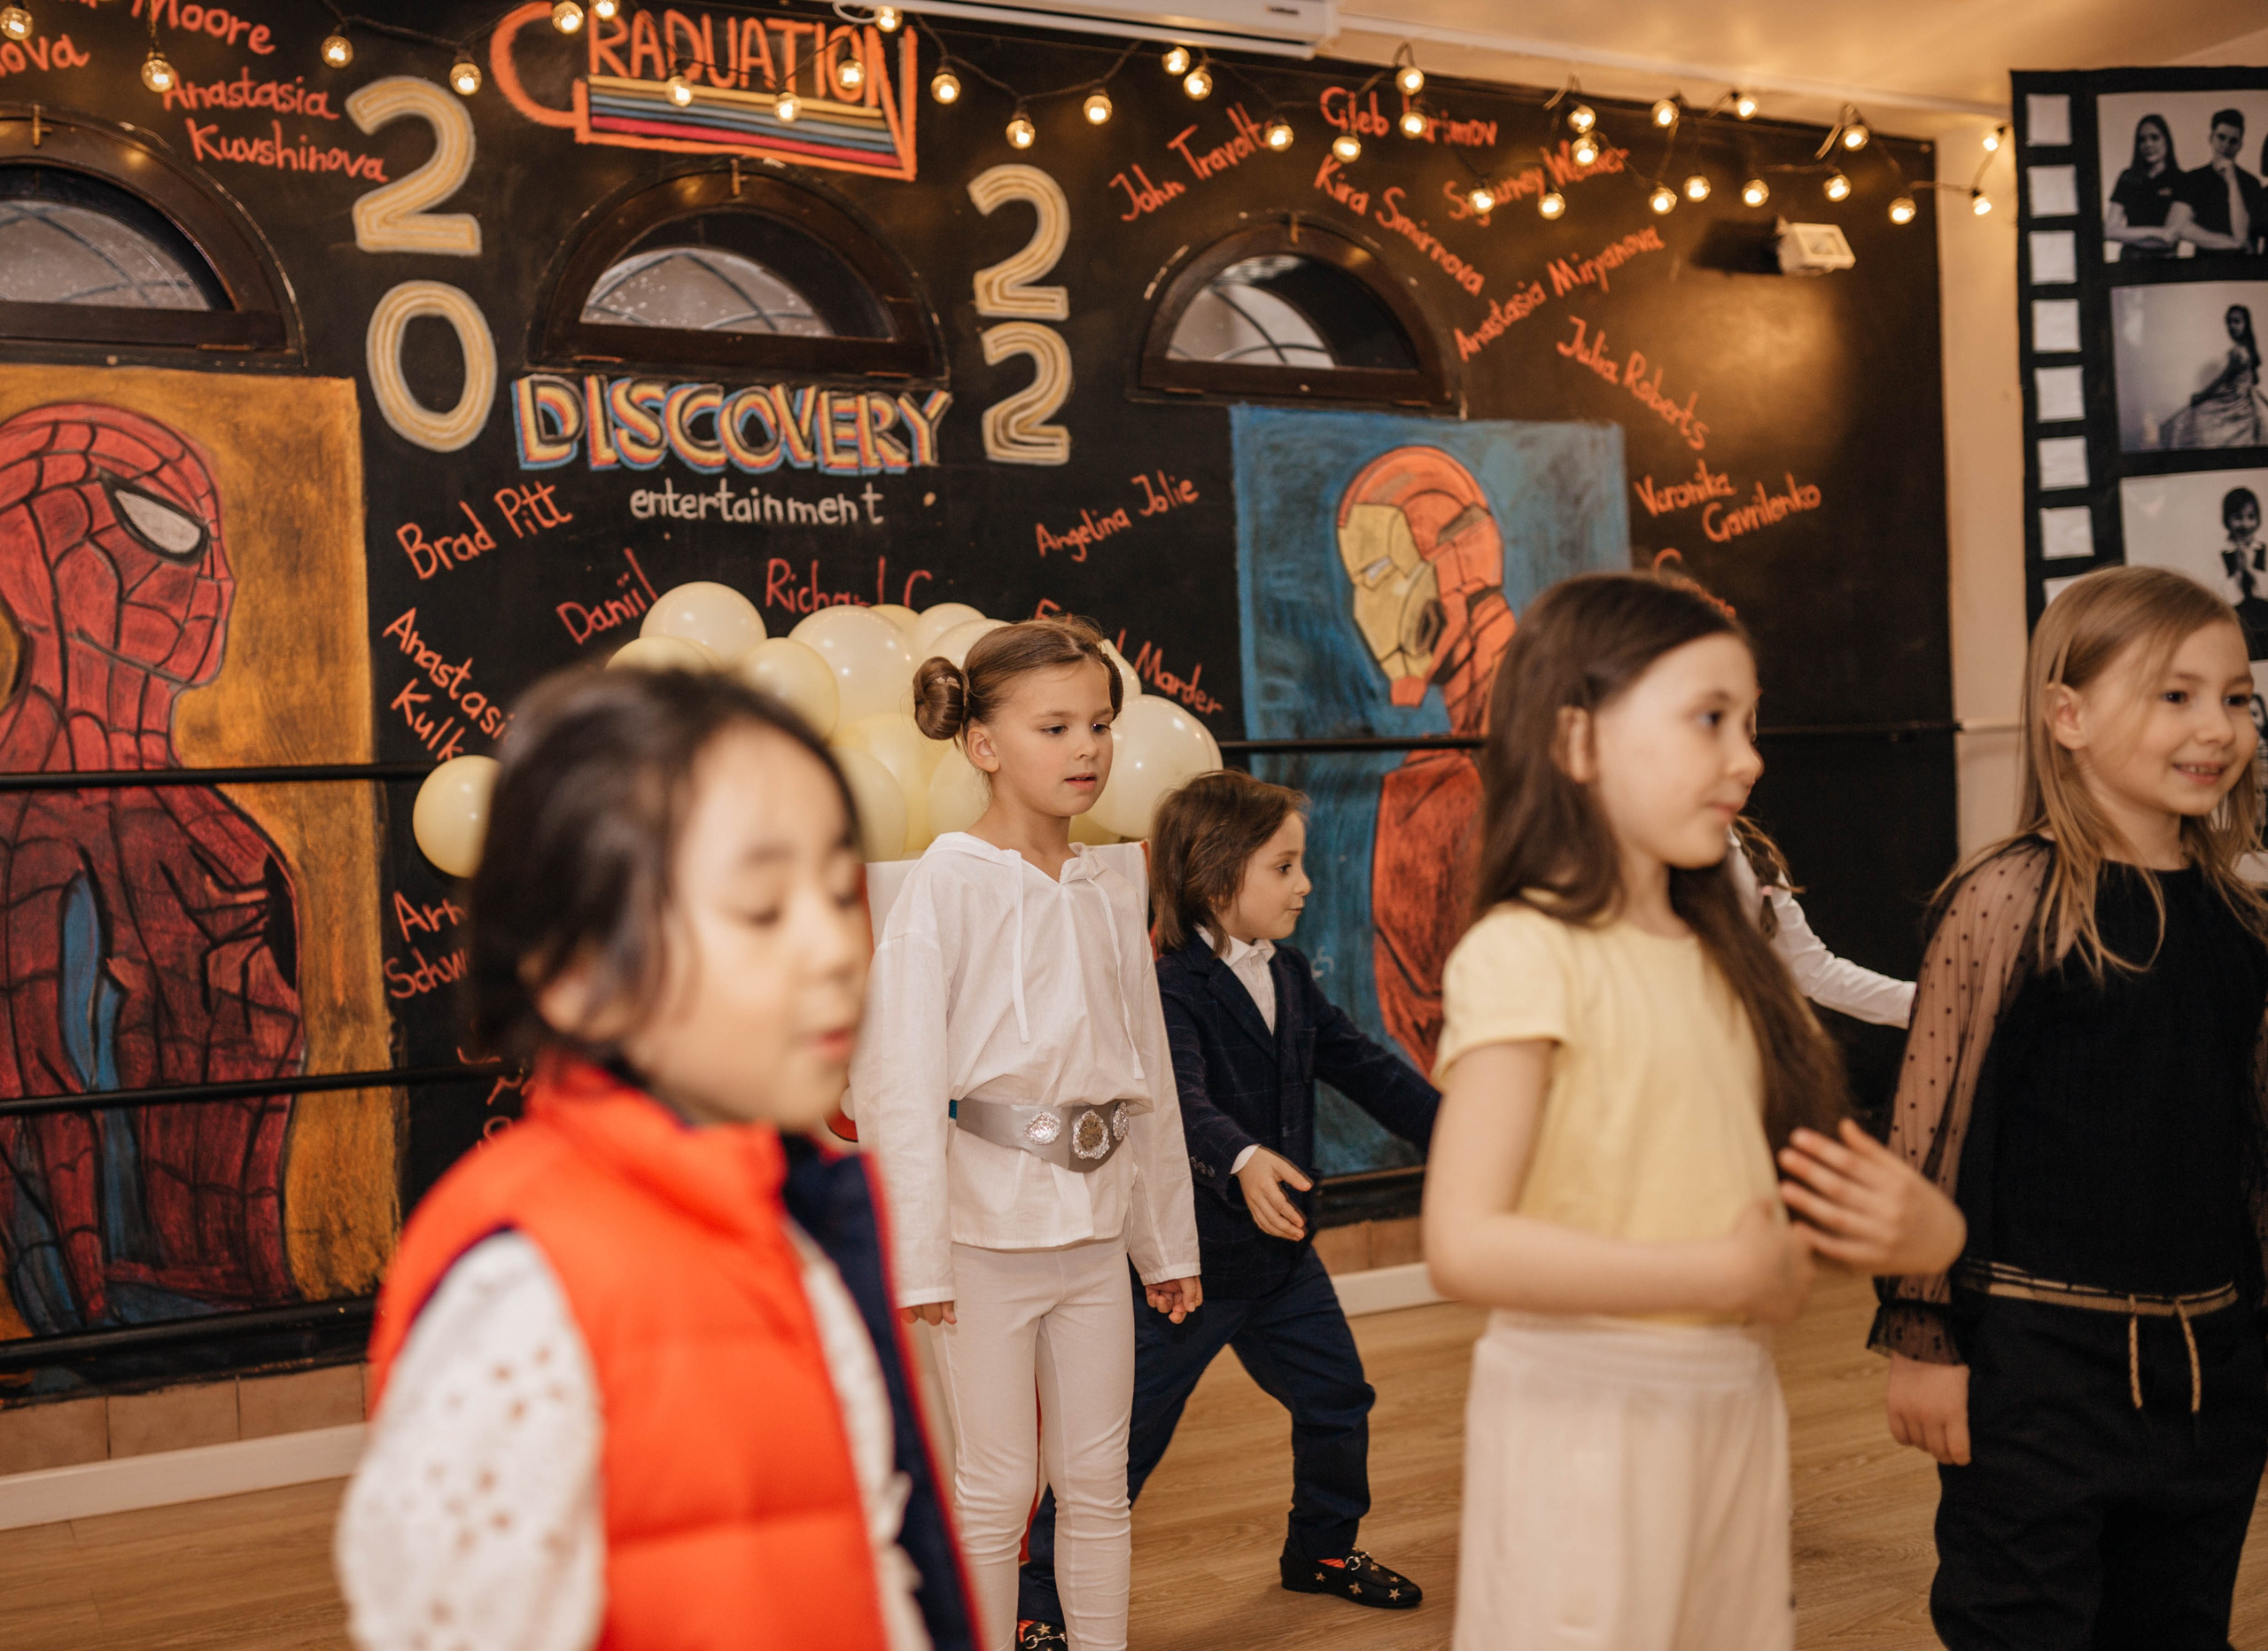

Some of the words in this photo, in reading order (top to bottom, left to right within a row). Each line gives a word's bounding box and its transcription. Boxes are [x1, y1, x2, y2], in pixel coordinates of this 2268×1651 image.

[162, 66, 340, 121] Anastasia
[490, 0, 918, 181] GRADUATION
[1320, 86, 1390, 137] Gleb
[184, 117, 390, 183] Kuvshinova
[1108, 163, 1187, 222] John
[1167, 102, 1278, 181] Travolt
[1375, 186, 1485, 297] Smirnova
[1454, 279, 1548, 362] Anastasia
[511, 373, 953, 478] DISCOVERY
[1556, 315, 1619, 385] Julia
[1622, 351, 1711, 451] Roberts
[396, 500, 497, 580] Brad
[494, 480, 573, 539] Pitt
[630, 478, 885, 526] entertainment
[1036, 508, 1132, 563] Angelina
[1131, 470, 1200, 517] Jolie
[382, 606, 517, 746] Anastasi
